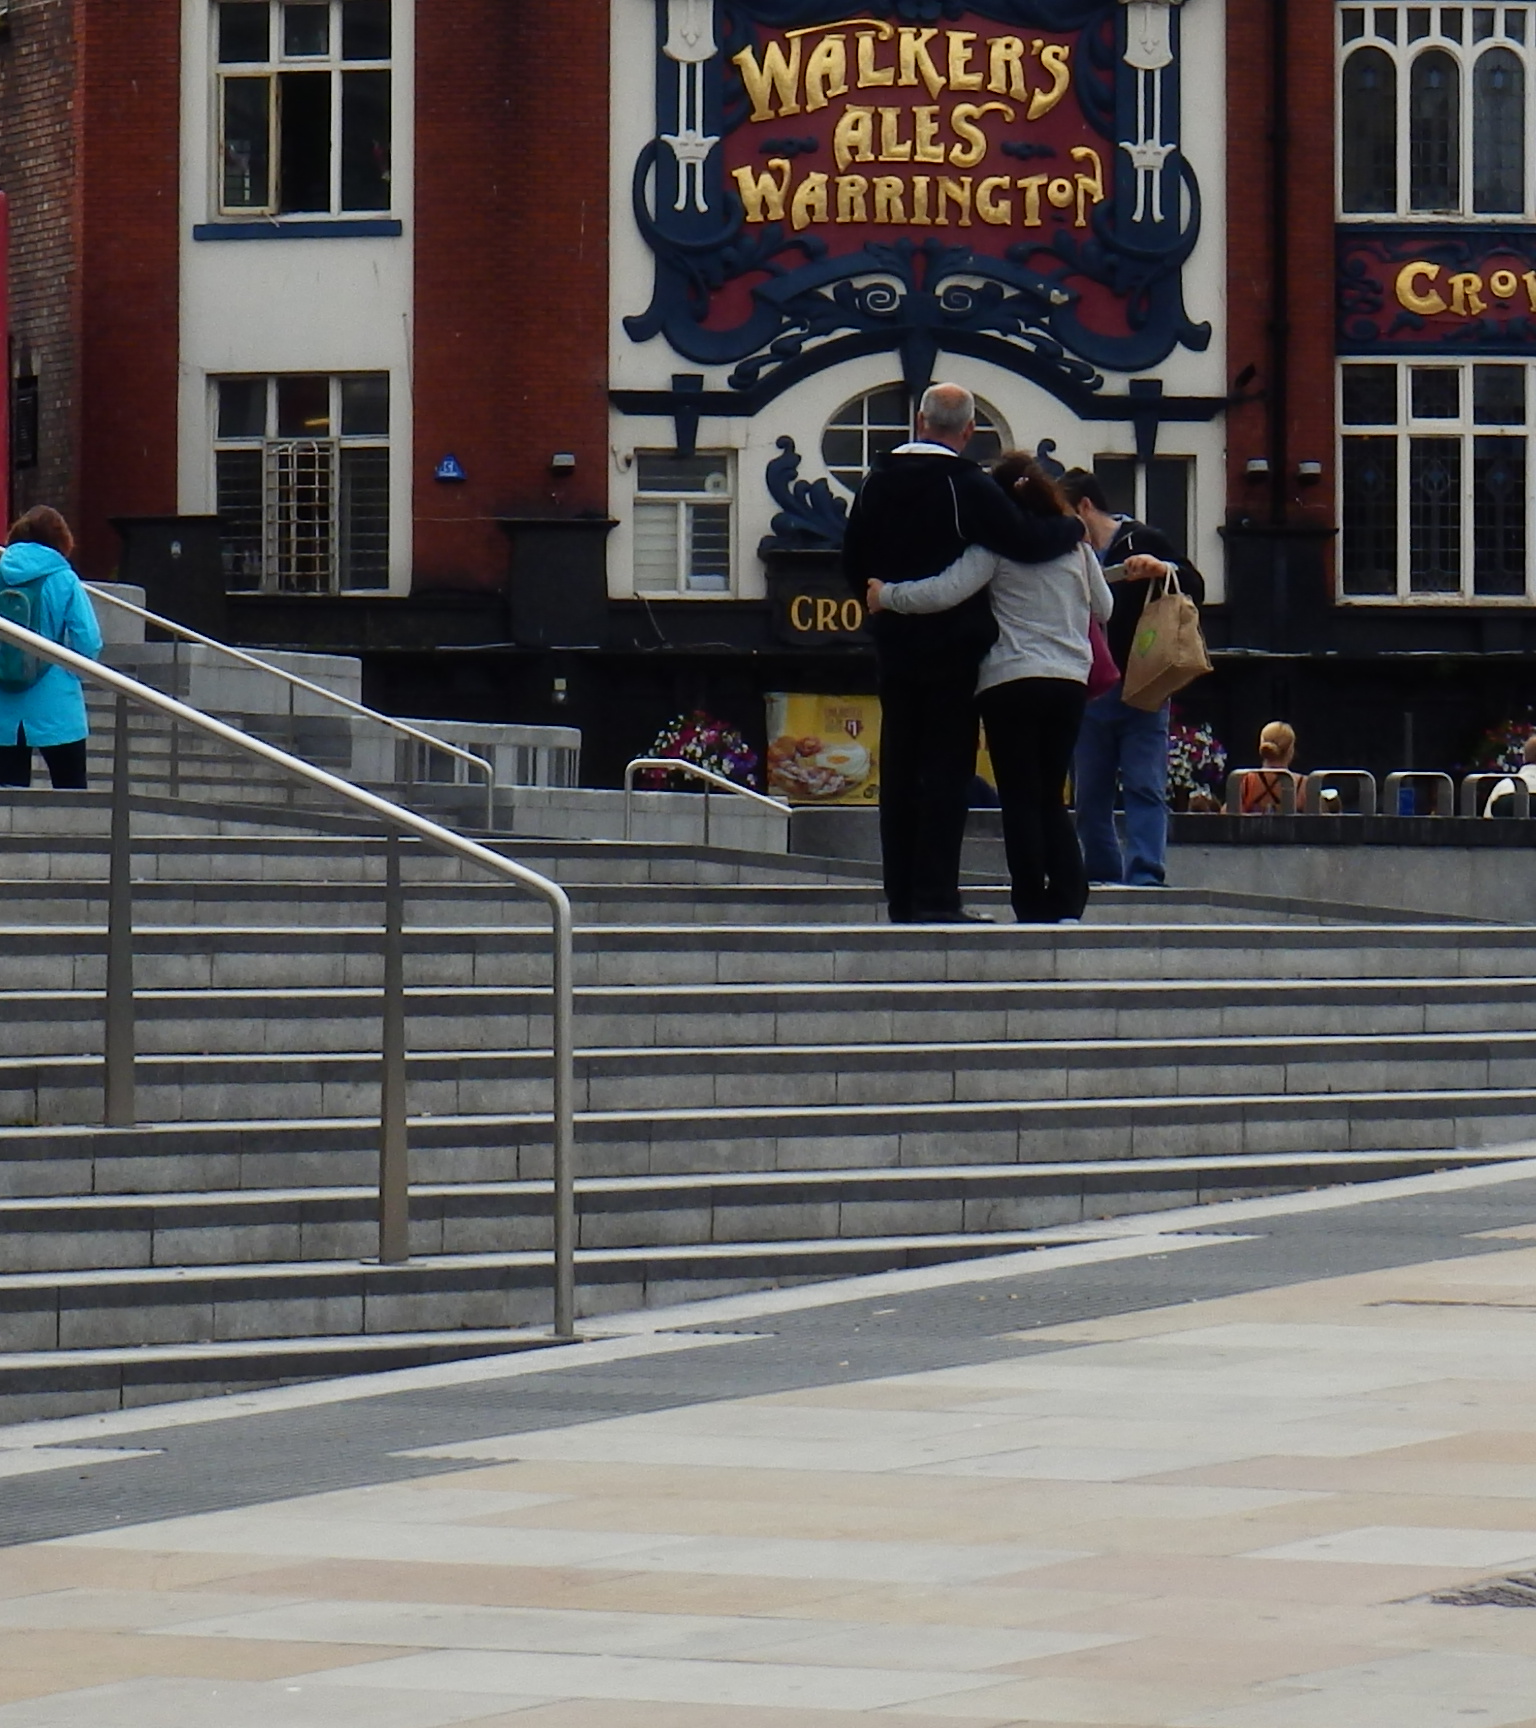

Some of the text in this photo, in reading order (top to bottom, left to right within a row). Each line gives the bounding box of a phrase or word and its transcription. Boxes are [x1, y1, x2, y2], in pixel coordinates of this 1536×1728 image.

[731, 19, 1071, 122] WALKER'S
[834, 102, 1015, 171] ALES
[731, 146, 1104, 232] WARRINGTON
[791, 595, 863, 631] CRO
